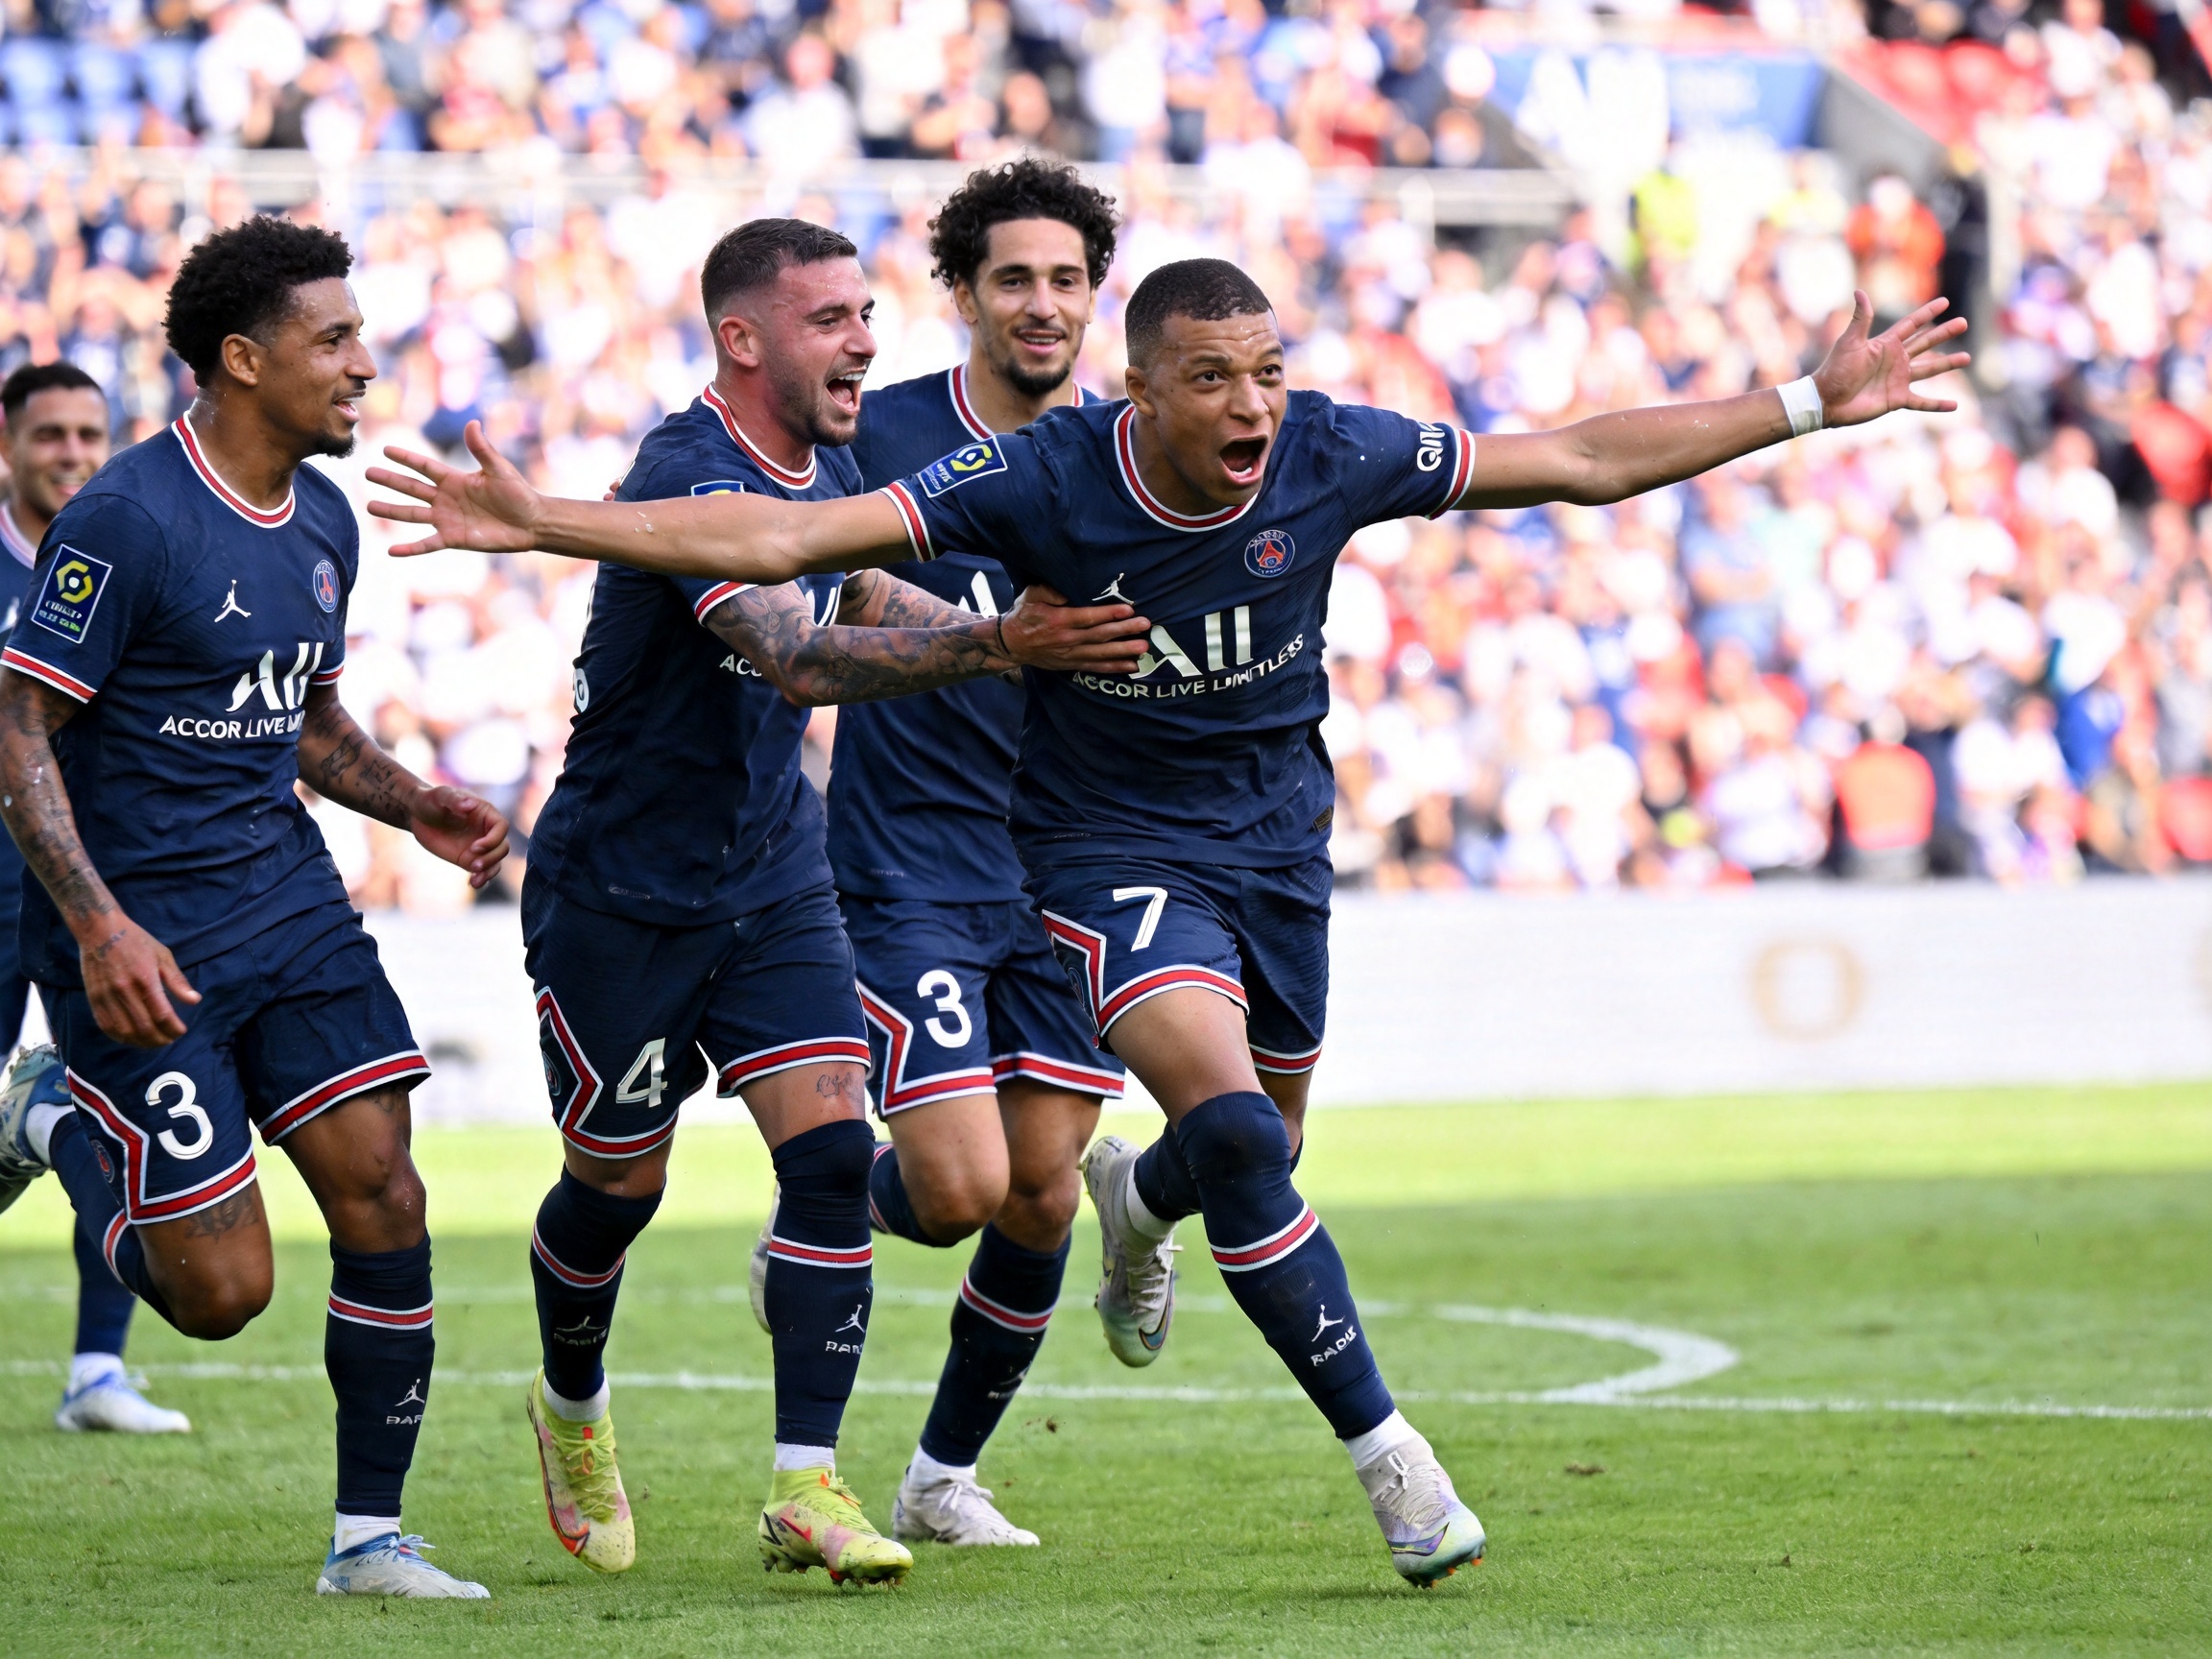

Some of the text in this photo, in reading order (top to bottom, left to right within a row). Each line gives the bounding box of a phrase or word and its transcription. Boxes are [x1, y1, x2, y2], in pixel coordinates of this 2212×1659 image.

[1156, 680, 1206, 699] LIVE
[158, 715, 242, 739] ACCOR
[245, 716, 286, 738] LIVE
[1112, 886, 1168, 952] 7
[917, 969, 973, 1048] 3
[615, 1036, 669, 1109] 4
[145, 1070, 214, 1161] 3
